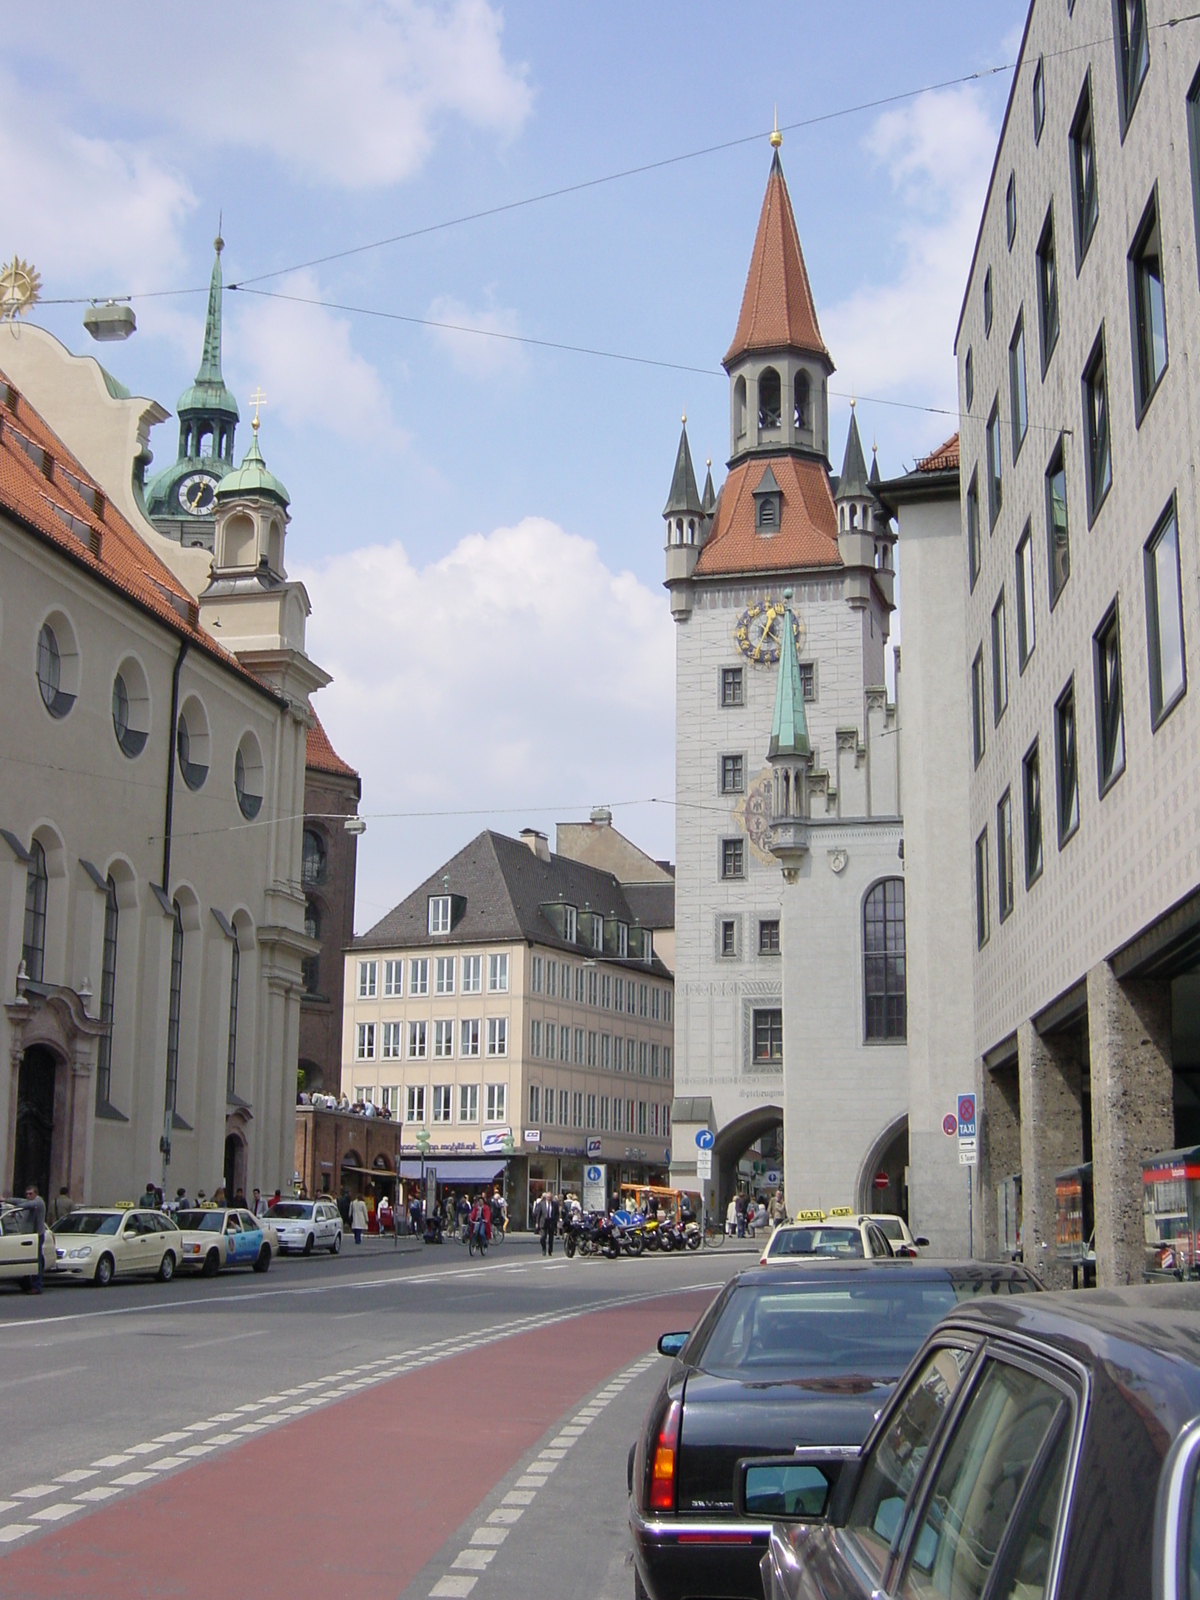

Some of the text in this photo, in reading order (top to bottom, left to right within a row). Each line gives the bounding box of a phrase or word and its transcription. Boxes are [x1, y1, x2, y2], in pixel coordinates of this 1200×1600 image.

[959, 1124, 975, 1134] TAXI
[588, 1141, 601, 1151] D2
[800, 1211, 822, 1219] TAXI
